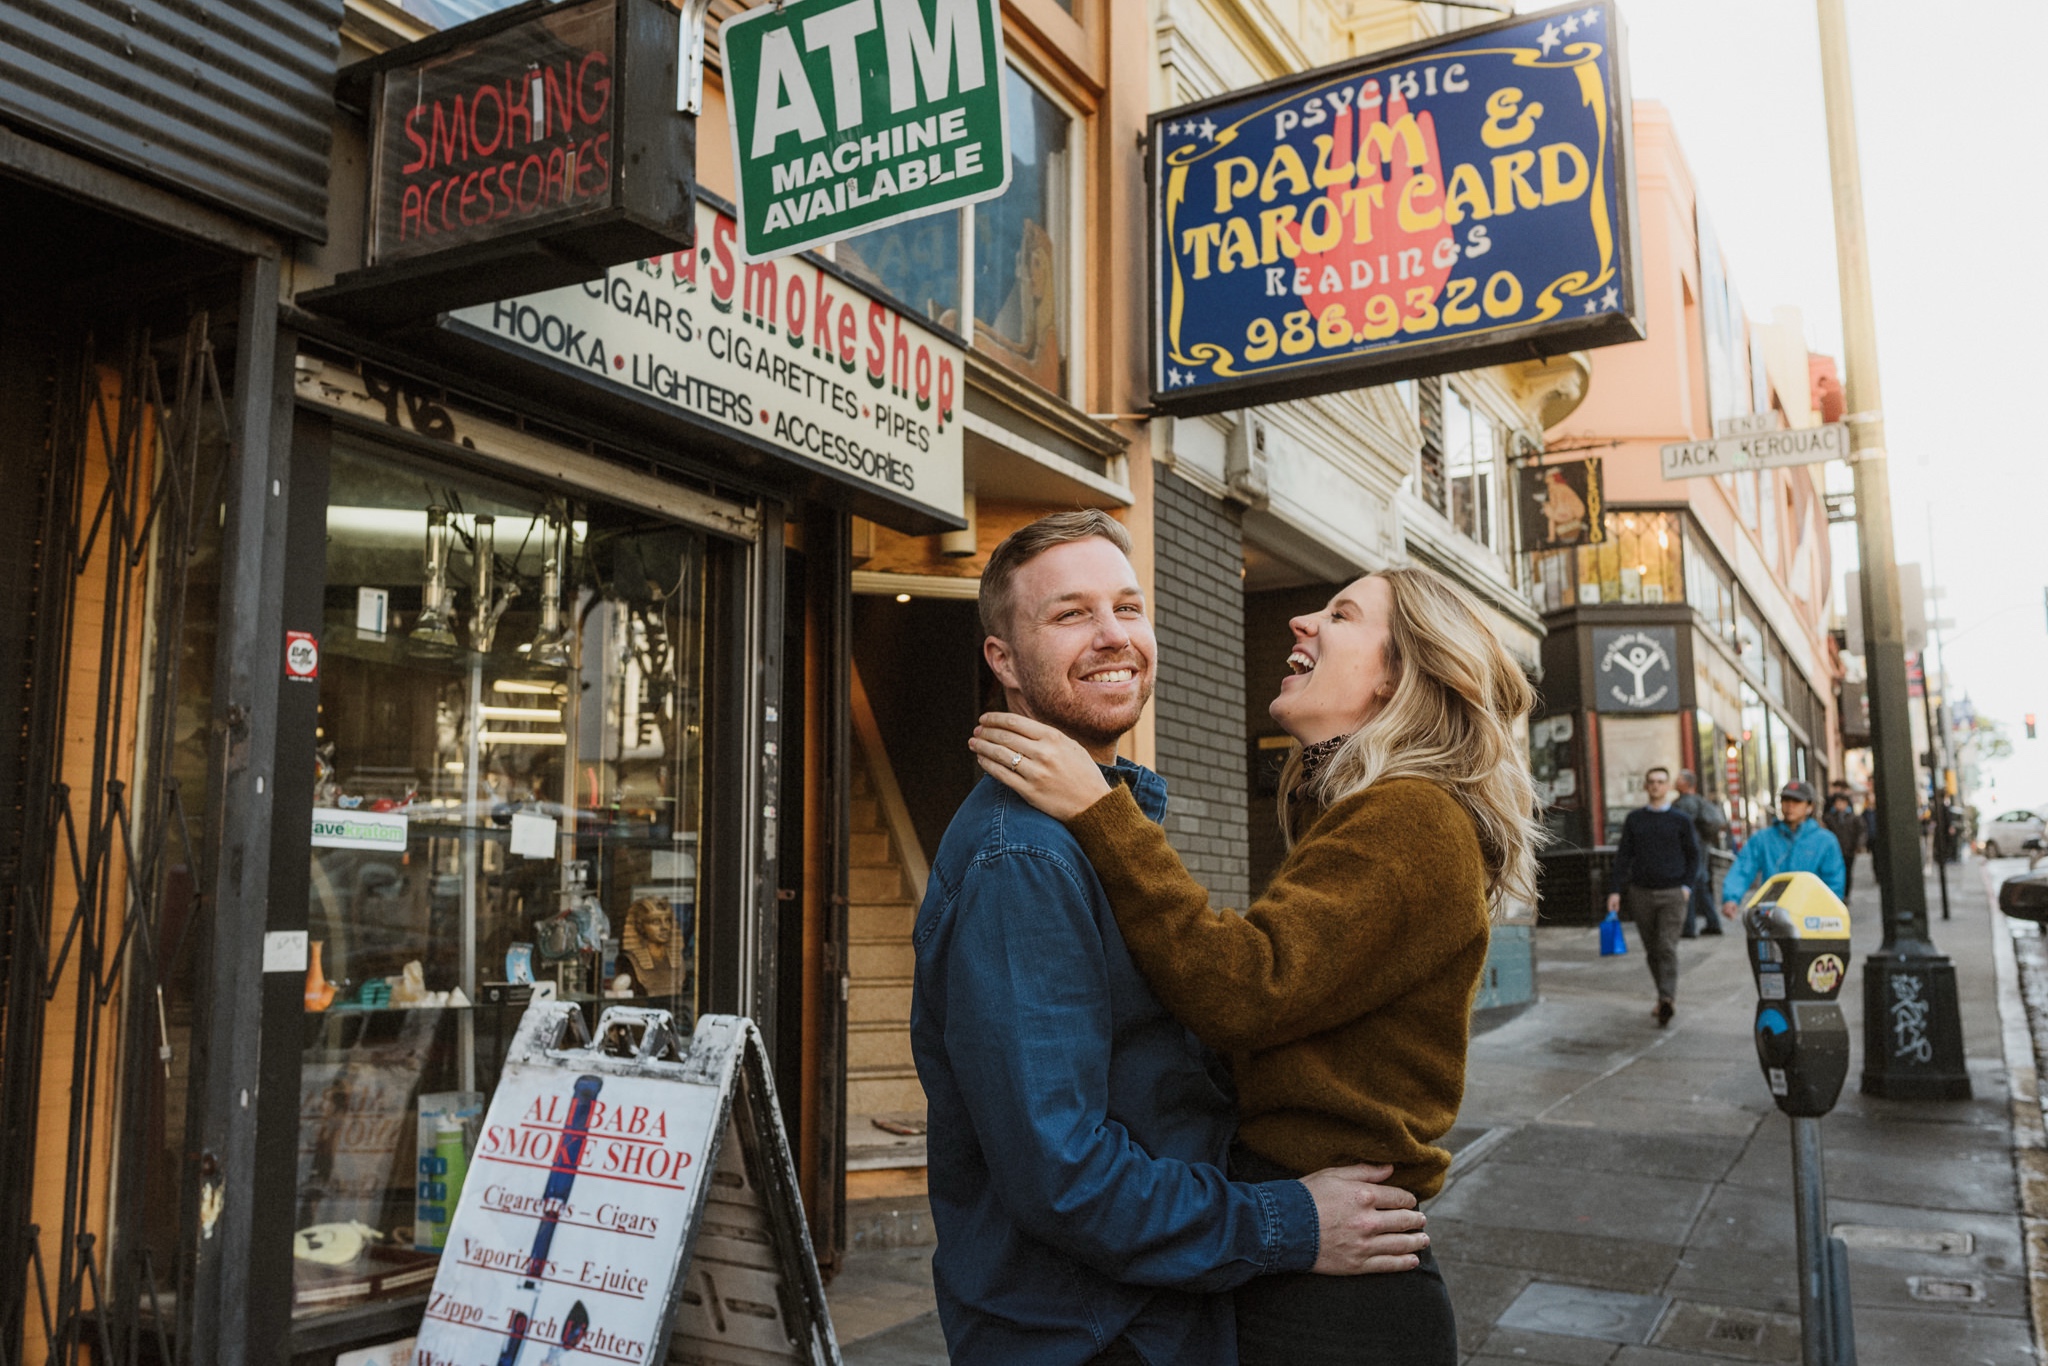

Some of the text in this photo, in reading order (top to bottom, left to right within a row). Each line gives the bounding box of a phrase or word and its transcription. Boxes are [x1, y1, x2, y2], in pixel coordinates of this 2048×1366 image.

[402, 51, 611, 175] SMOKING
[751, 0, 986, 160] ATM
[1275, 63, 1470, 141] PSYCHIC
[400, 132, 611, 242] ACCESSORIES
[762, 142, 984, 235] AVAILABLE
[771, 107, 968, 195] MACHINE
[1213, 87, 1544, 214] PALM &
[1182, 142, 1590, 280] TAROT CARD
[1244, 270, 1523, 362] 986.9320
[493, 300, 915, 491] HOOKA LIGHTERS ACCESSORIES
[707, 327, 859, 420] CIGARETTES
[875, 403, 930, 453] PIPES
[1729, 416, 1767, 433] END
[1669, 443, 1720, 469] JACK
[1739, 430, 1835, 459] KEROUAC
[482, 1124, 693, 1181] SMOKE SHOP
[523, 1095, 669, 1139] ALI BABA
[483, 1184, 576, 1219] Cigarettes
[596, 1203, 660, 1234] Cigars
[463, 1238, 556, 1277] Vaporizers
[579, 1260, 649, 1295] E-juice
[428, 1291, 483, 1324] Zippo
[506, 1307, 558, 1338] Torch
[562, 1319, 646, 1360] Lighters
